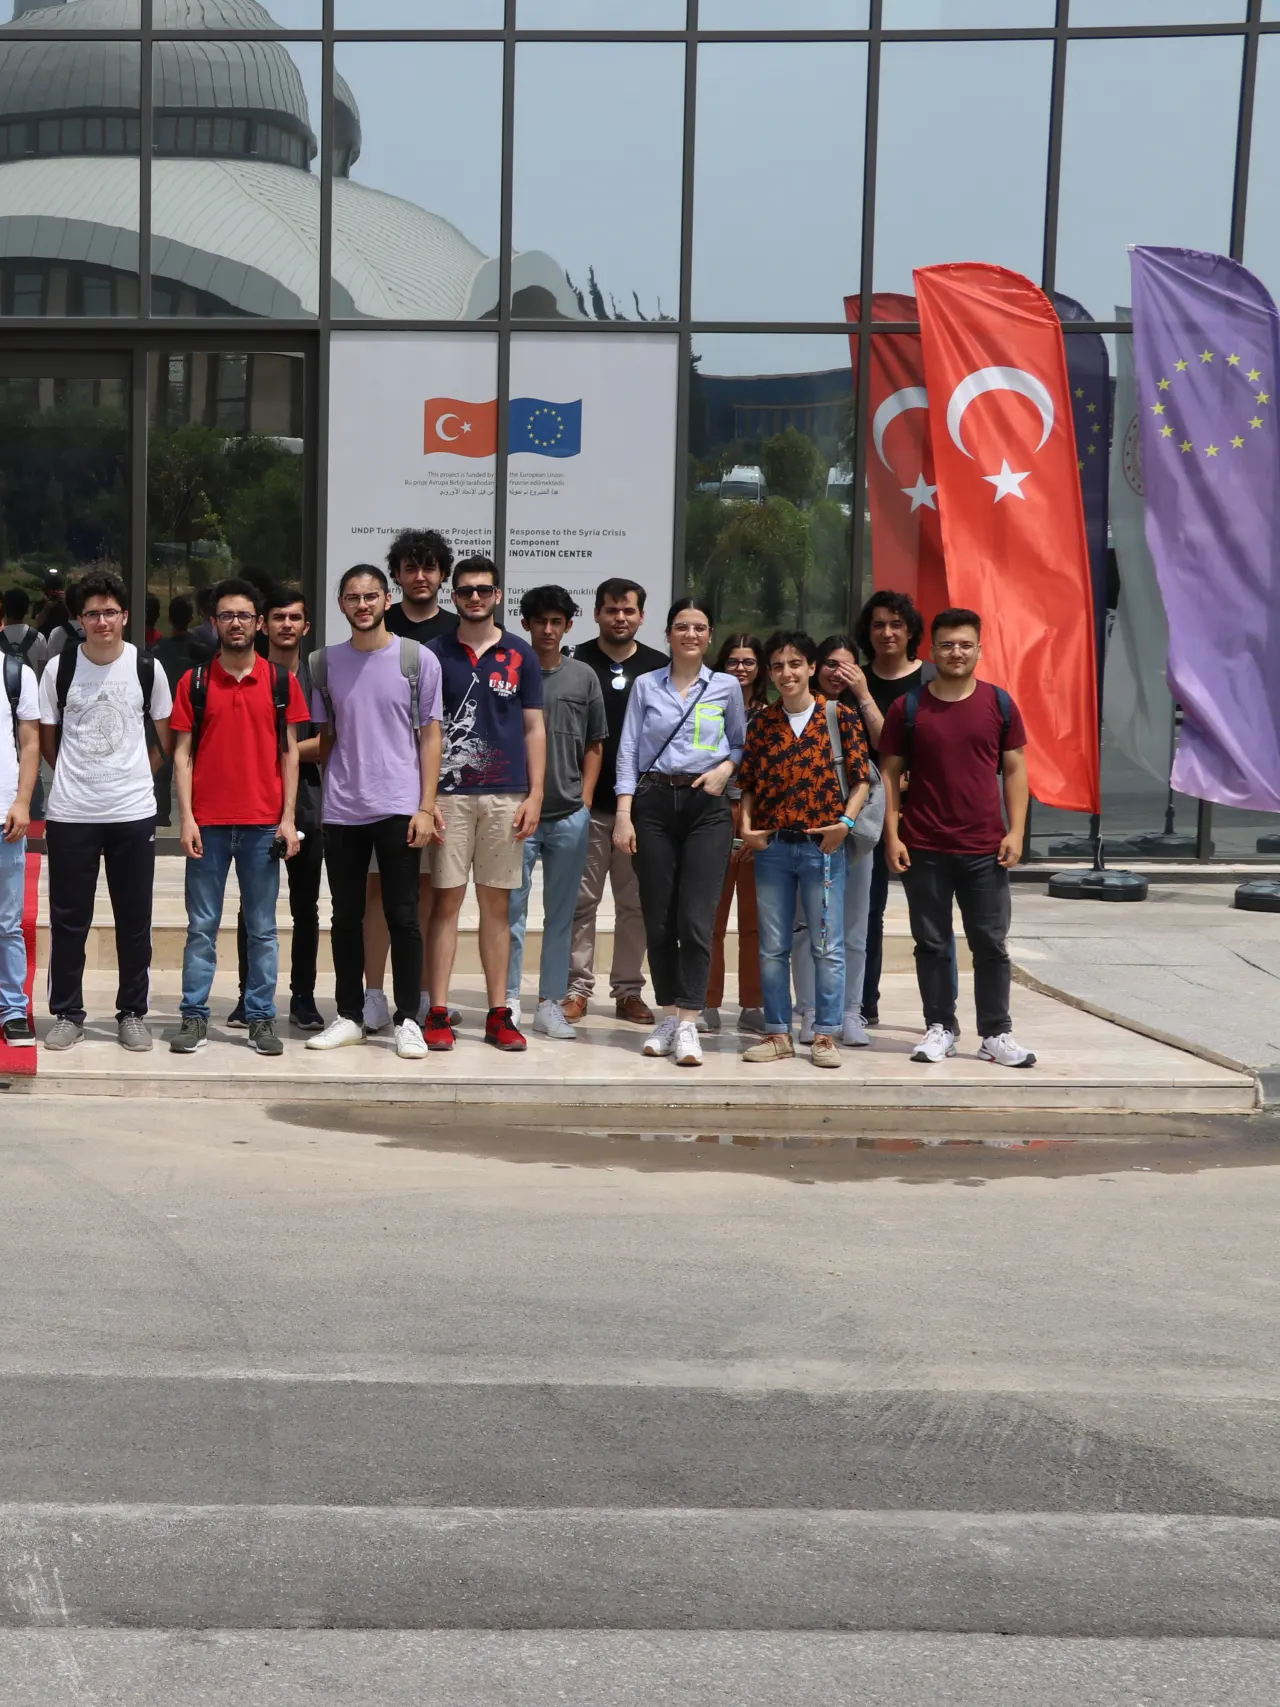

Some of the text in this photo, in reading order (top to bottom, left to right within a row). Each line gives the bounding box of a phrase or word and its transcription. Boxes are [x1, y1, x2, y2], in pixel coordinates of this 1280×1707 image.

[440, 471, 459, 479] project
[487, 471, 494, 479] by
[452, 528, 482, 536] Project
[509, 528, 550, 537] Response
[552, 528, 561, 536] to
[563, 528, 577, 536] the
[578, 529, 601, 538] Syria
[510, 539, 560, 547] Component
[457, 548, 593, 558] MERSİN INOVATION CENTER
